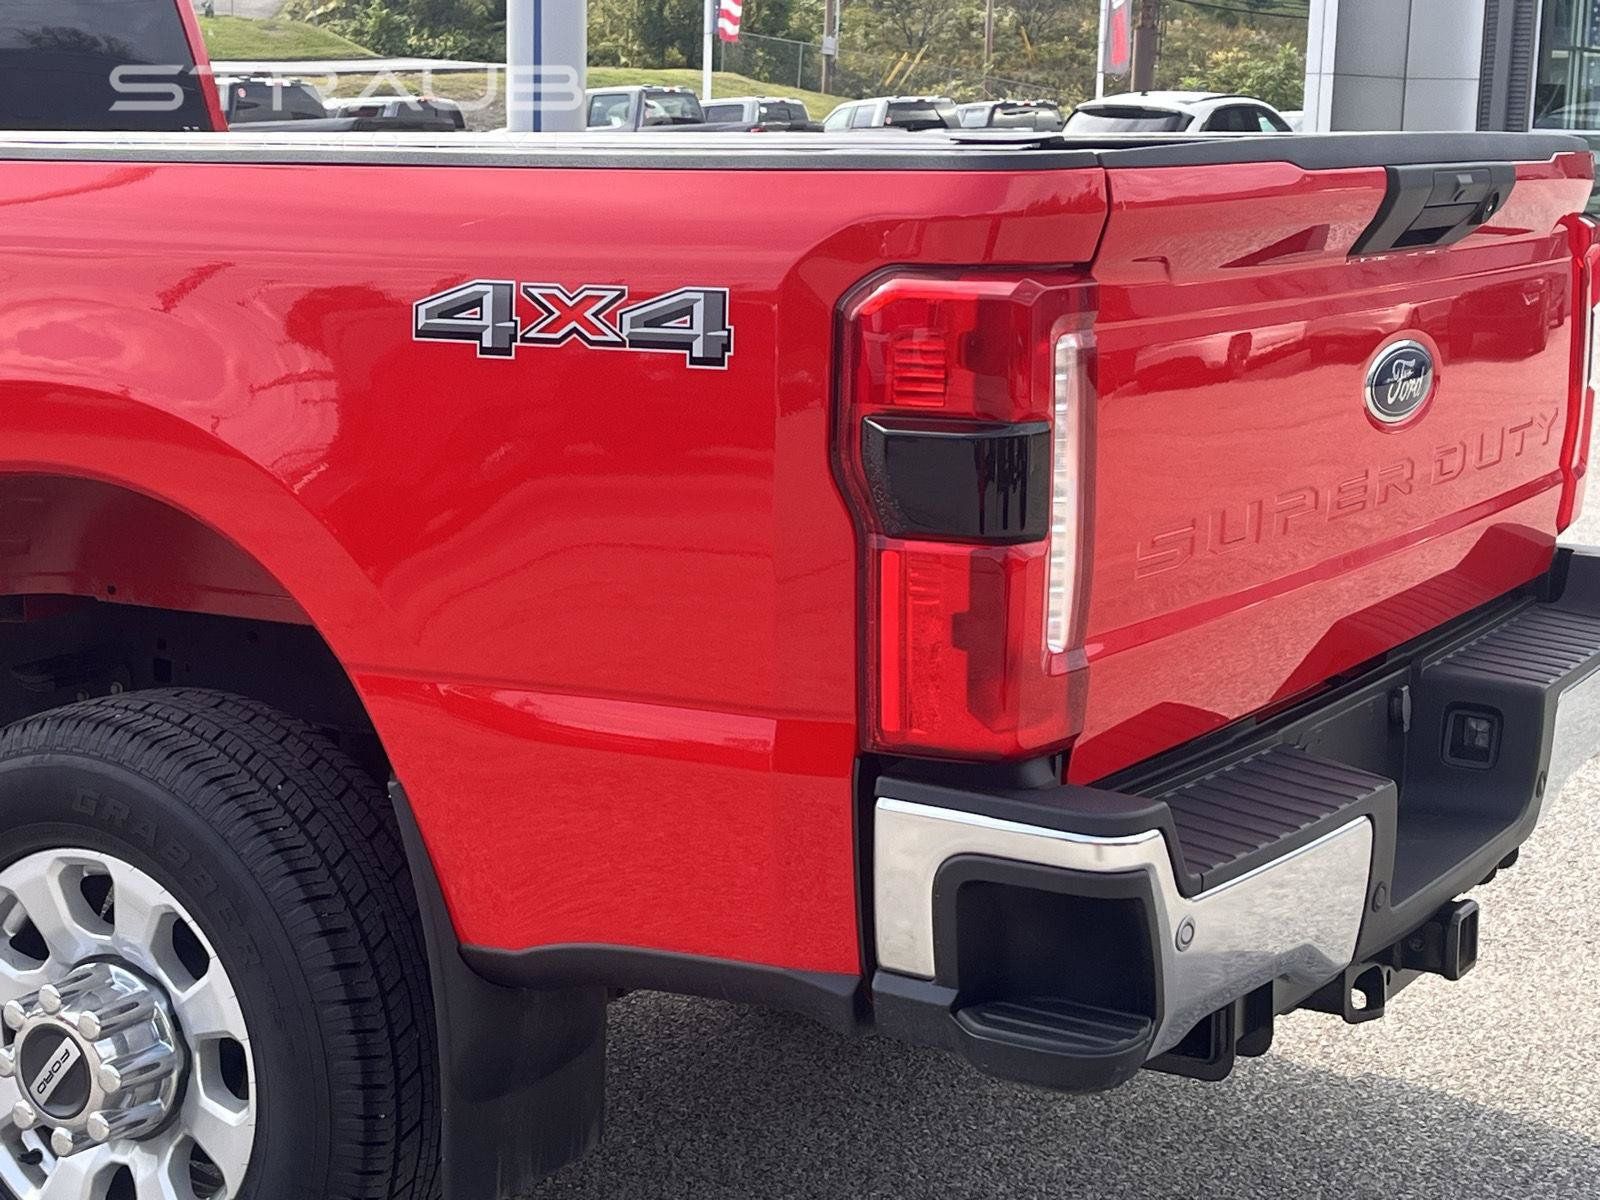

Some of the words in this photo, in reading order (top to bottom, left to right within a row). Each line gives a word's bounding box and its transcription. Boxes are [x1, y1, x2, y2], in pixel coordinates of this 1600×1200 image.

[1387, 359, 1425, 405] Ford
[1134, 462, 1414, 580] SUPER
[1431, 407, 1560, 486] DUTY
[72, 786, 264, 967] GRABBER
[37, 1048, 70, 1094] FORD
